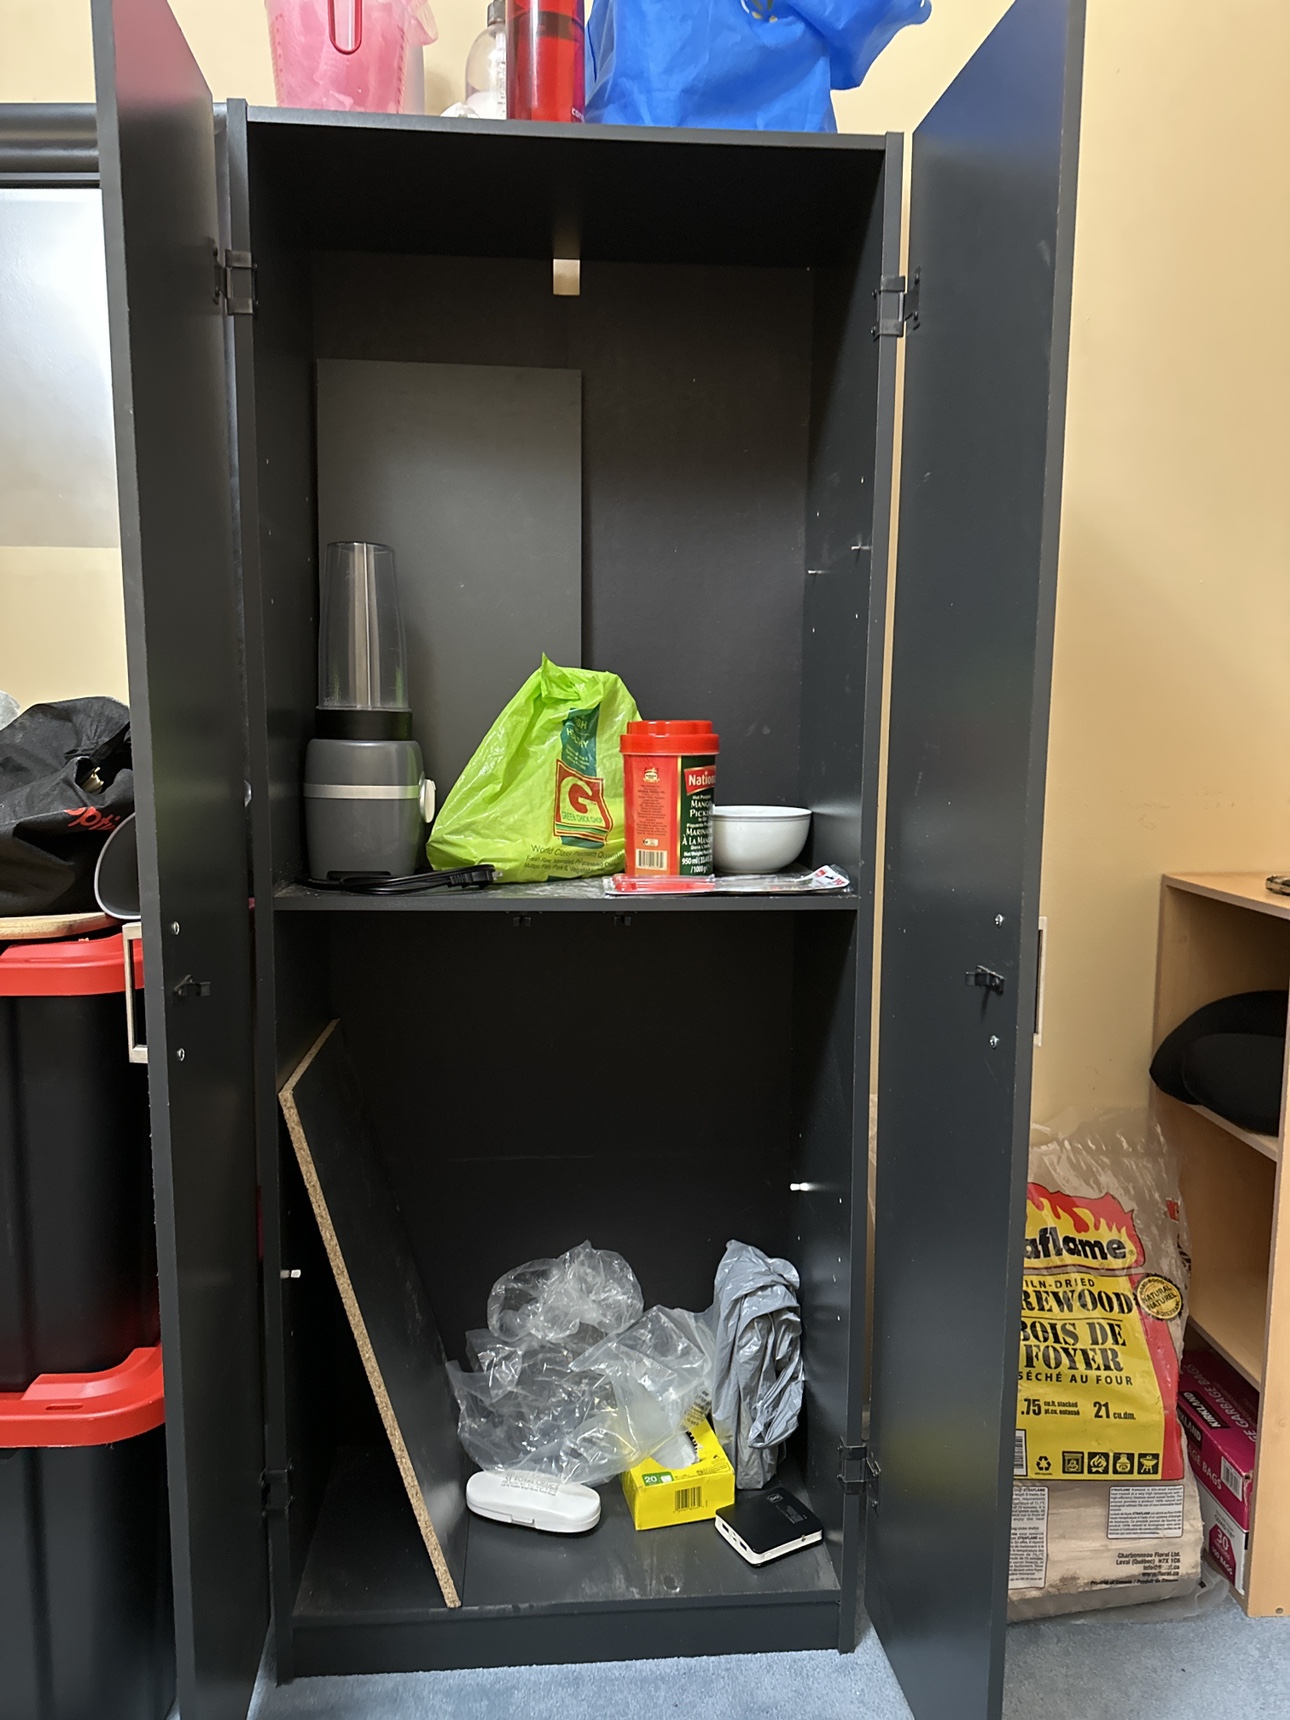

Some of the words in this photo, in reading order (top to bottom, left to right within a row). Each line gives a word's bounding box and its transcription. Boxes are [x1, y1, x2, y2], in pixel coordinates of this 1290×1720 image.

[531, 845, 554, 855] World
[1143, 1285, 1172, 1303] NATURAL
[1147, 1292, 1177, 1311] NATUREL
[1020, 1320, 1079, 1346] BOIS
[1087, 1321, 1127, 1346] DE
[1023, 1344, 1124, 1372] FOYER
[1018, 1370, 1062, 1383] SÉCHÉ
[1069, 1374, 1089, 1384] AU
[1096, 1375, 1133, 1386] FOUR
[1093, 1401, 1110, 1419] 21
[1184, 1392, 1221, 1428] KIRKLAND
[1204, 1386, 1249, 1428] GARBAGE
[1202, 1462, 1222, 1490] BAGS
[1217, 1529, 1229, 1551] 30
